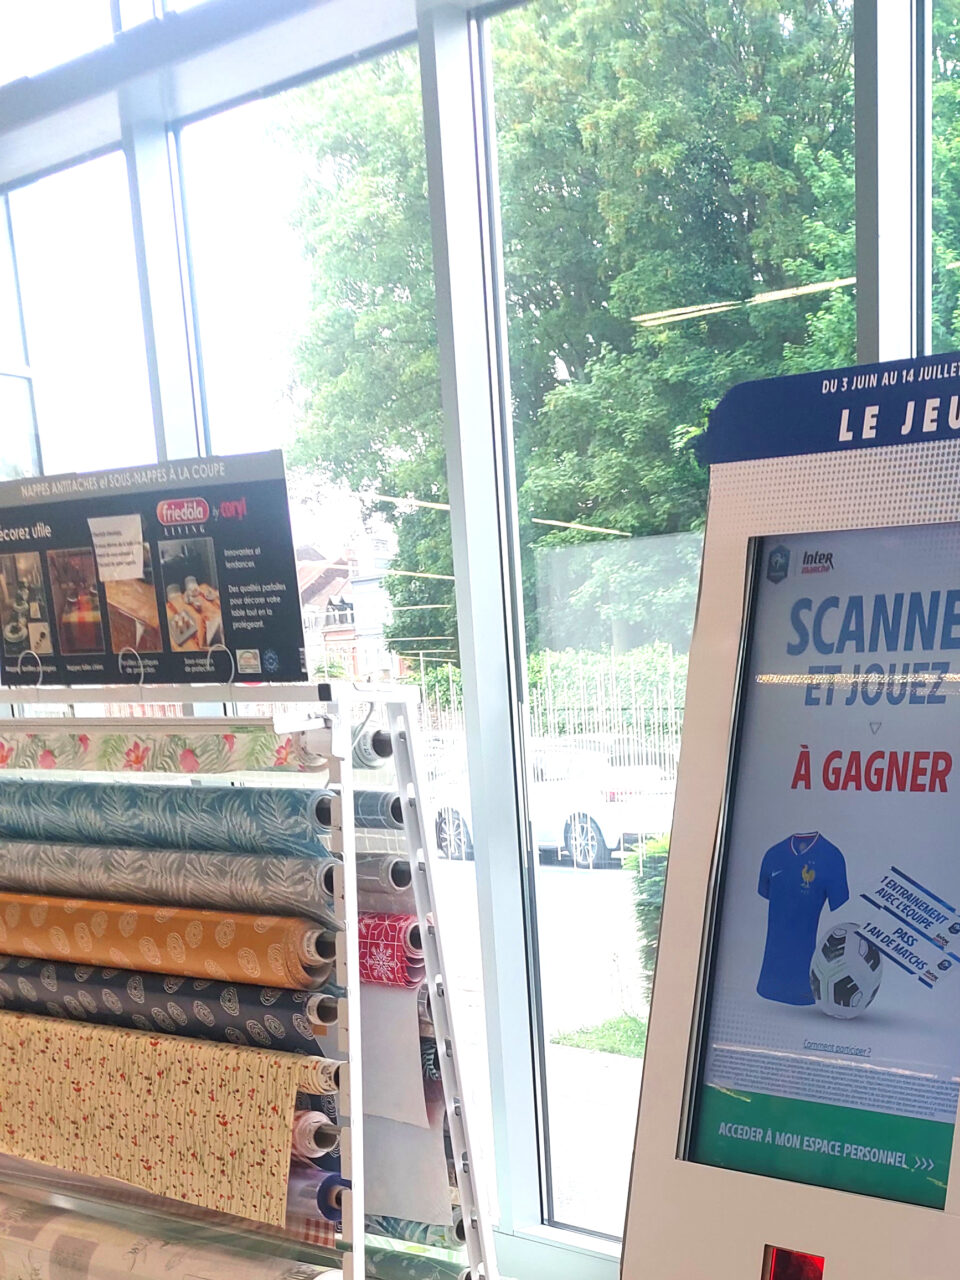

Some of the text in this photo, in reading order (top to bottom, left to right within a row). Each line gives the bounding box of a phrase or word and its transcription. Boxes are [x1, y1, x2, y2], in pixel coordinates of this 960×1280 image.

[822, 380, 837, 394] DU
[841, 378, 848, 392] 3
[852, 372, 878, 390] JUIN
[882, 371, 897, 387] AU
[902, 368, 914, 384] 14
[839, 405, 880, 442] LE
[21, 483, 50, 497] NAPPES
[110, 468, 167, 487] SOUS-NAPPES
[169, 464, 176, 480] À
[178, 466, 190, 480] LA
[192, 463, 225, 478] COUPE
[805, 662, 951, 706] ET JOUEZ
[791, 744, 952, 792] À GAGNER
[875, 887, 898, 906] AVEC
[880, 876, 949, 924] 1 ENTRAINEMENT
[868, 925, 882, 939] AN
[881, 934, 895, 947] DE
[892, 943, 928, 970] MATCHS
[893, 927, 918, 947] PASS
[718, 1122, 764, 1143] ACCEDER
[775, 1131, 800, 1149] MON
[803, 1136, 841, 1156] ESPACE
[843, 1143, 907, 1168] PERSONNEL
